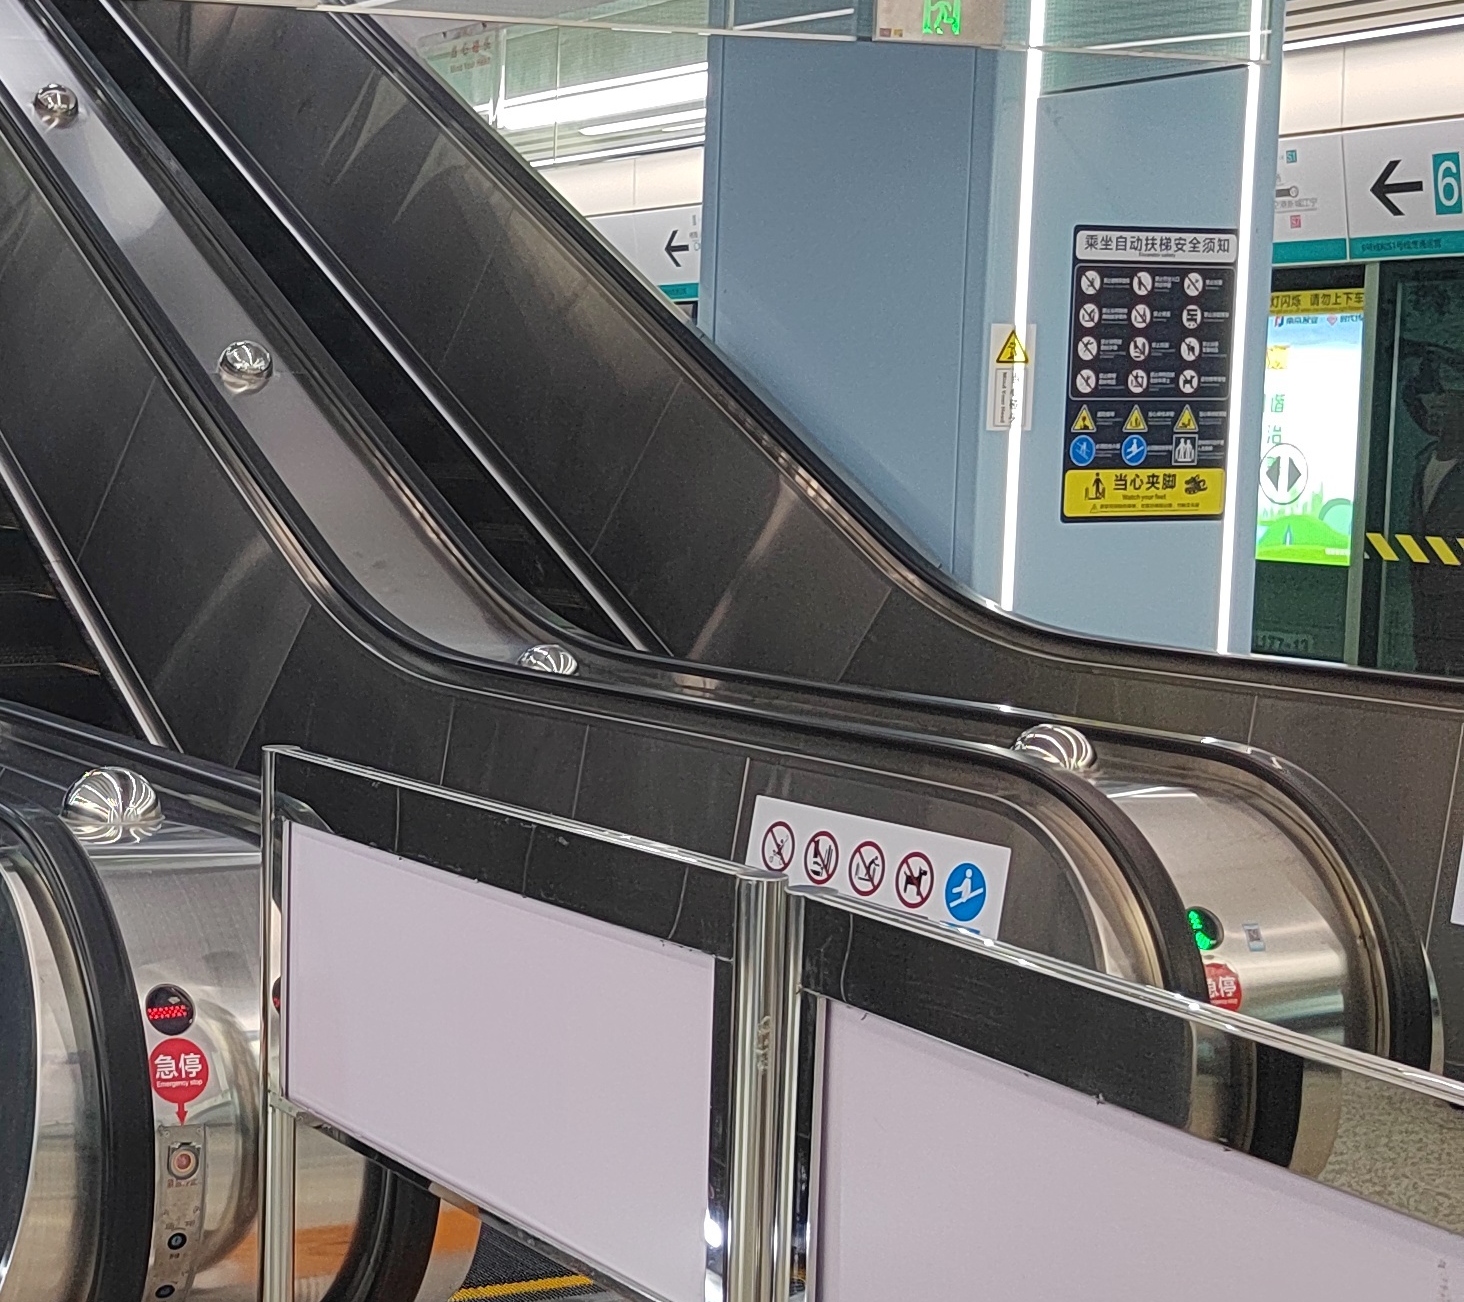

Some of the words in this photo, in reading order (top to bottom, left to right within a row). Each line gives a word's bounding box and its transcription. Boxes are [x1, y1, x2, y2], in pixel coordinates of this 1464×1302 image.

[1437, 160, 1460, 207] 6
[1084, 234, 1231, 254] 乘坐自动扶梯安全须知
[1113, 472, 1177, 492] 当心夹脚
[154, 1053, 203, 1079] 急停
[156, 1080, 189, 1088] Emergency
[190, 1078, 203, 1086] stop
